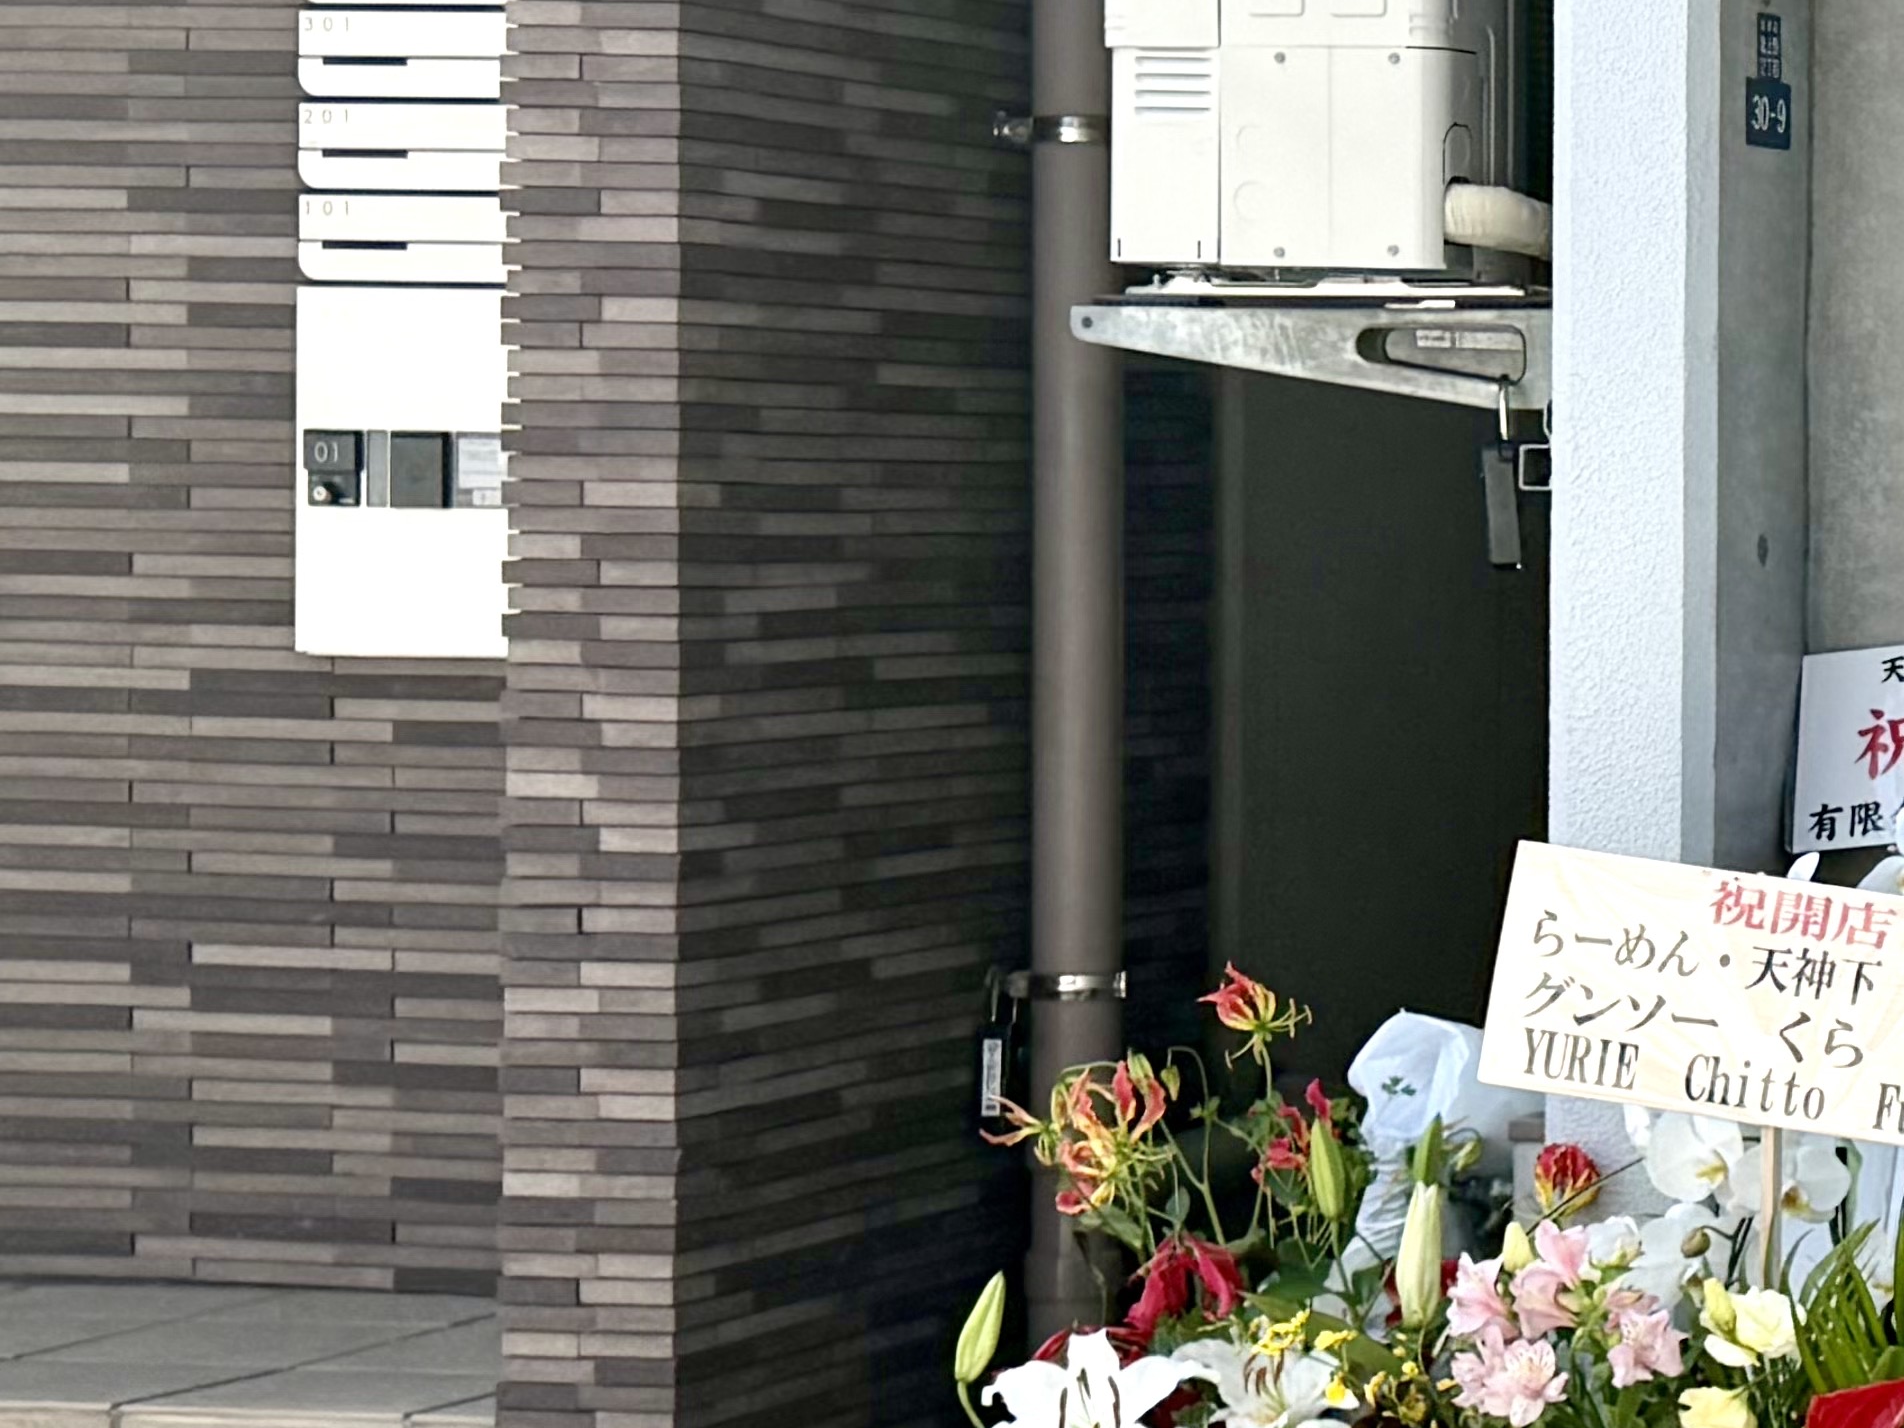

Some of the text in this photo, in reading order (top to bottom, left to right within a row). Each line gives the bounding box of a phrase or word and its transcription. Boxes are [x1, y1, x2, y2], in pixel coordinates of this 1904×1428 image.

[1709, 876, 1899, 951] 祝開店
[1523, 1027, 1640, 1091] YURIE
[1683, 1052, 1826, 1121] Chitto
[1779, 1010, 1864, 1069] くら
